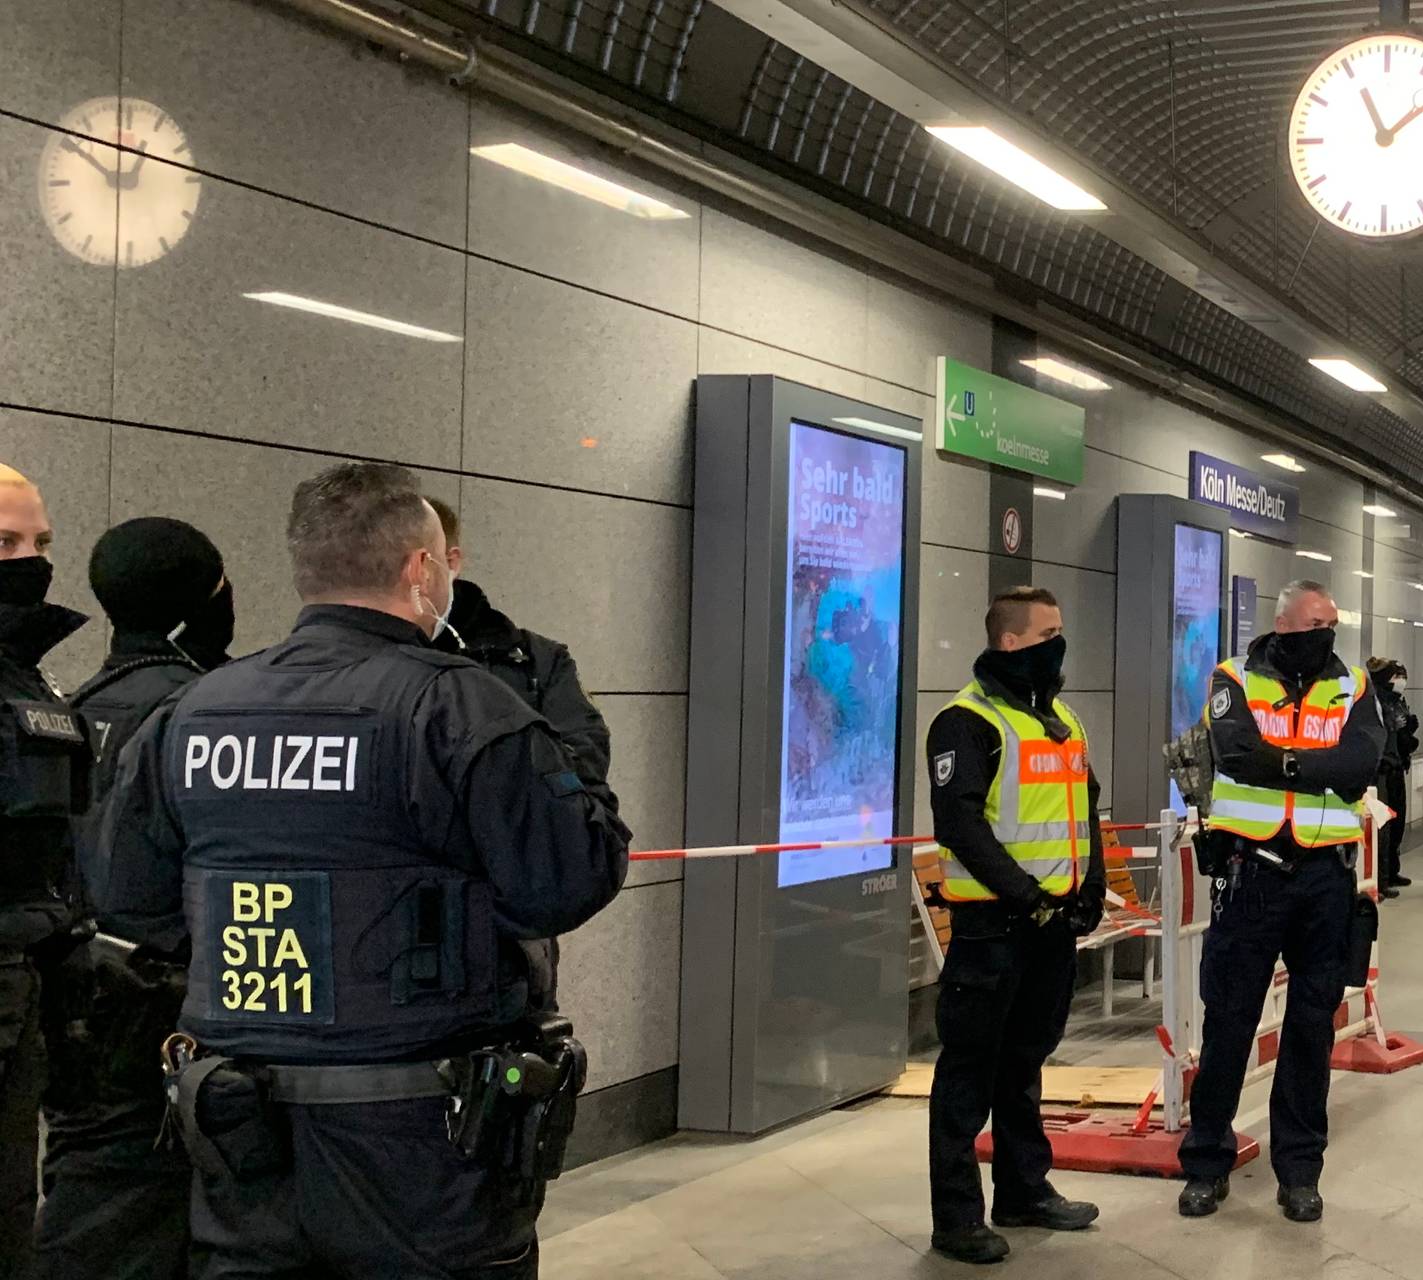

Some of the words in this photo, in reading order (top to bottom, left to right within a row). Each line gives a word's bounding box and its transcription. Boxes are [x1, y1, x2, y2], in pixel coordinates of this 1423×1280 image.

[996, 432, 1050, 466] koelnmesse
[801, 457, 848, 497] Sehr
[853, 466, 894, 505] bald
[1200, 465, 1225, 504] Köln
[1226, 474, 1287, 522] Messe/Deutz
[800, 492, 857, 531] Sports
[26, 709, 76, 736] POLIZEI
[184, 734, 359, 792] POLIZEI
[232, 881, 294, 923] BP
[222, 925, 310, 969] STA
[221, 969, 313, 1014] 3211
